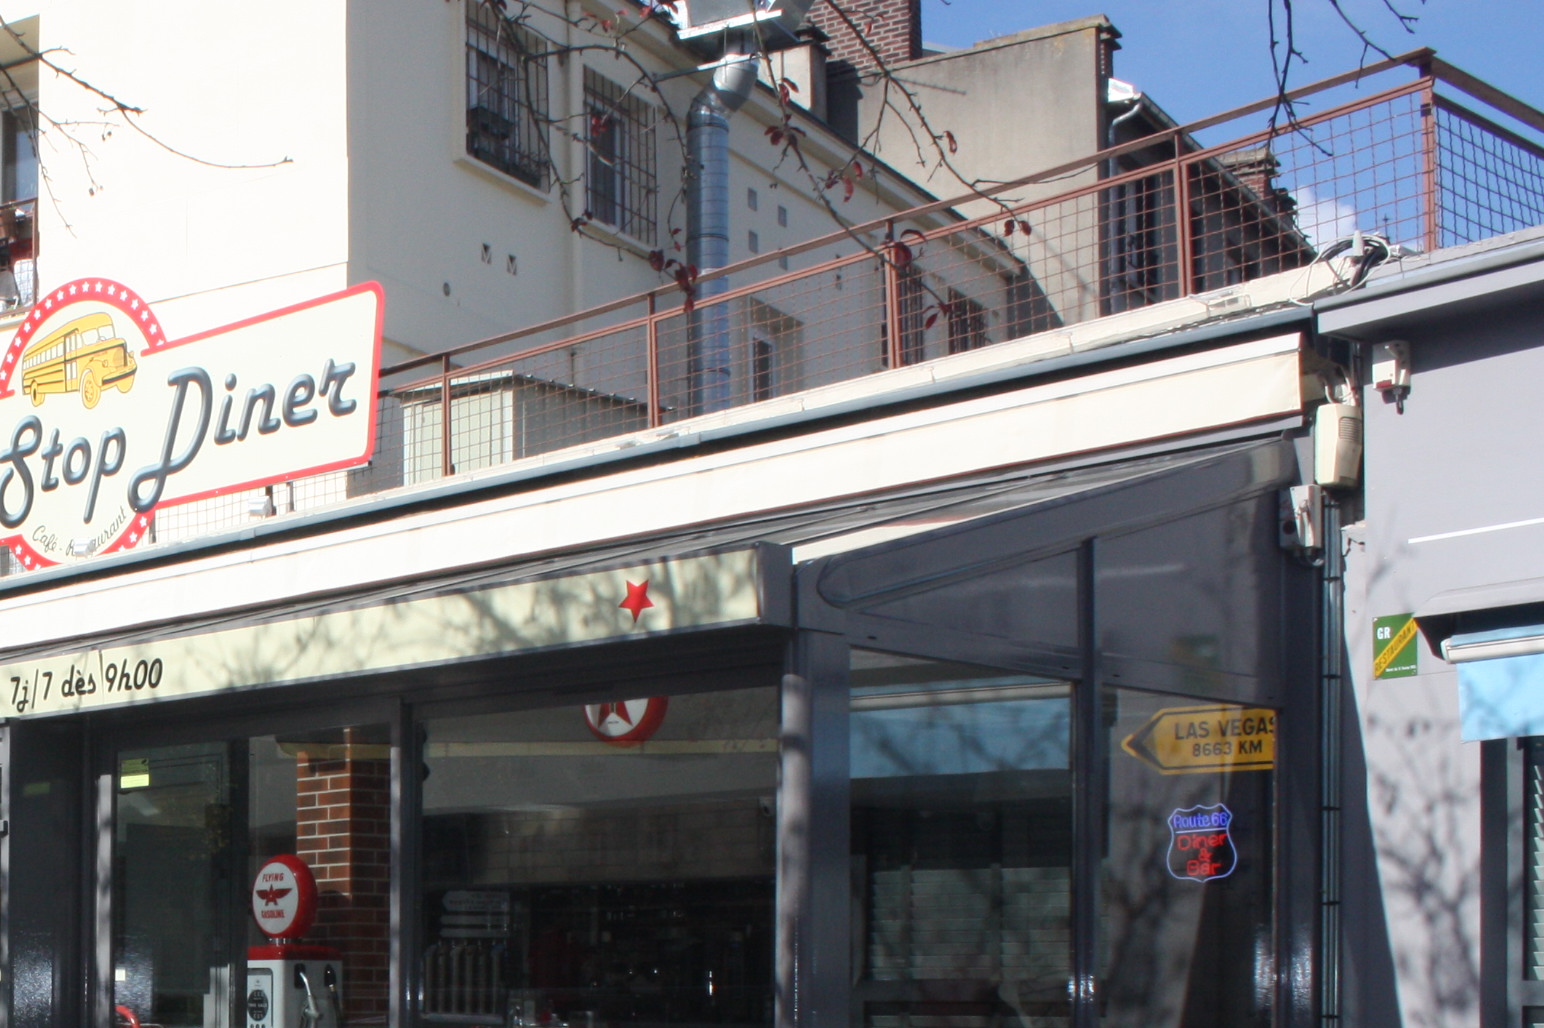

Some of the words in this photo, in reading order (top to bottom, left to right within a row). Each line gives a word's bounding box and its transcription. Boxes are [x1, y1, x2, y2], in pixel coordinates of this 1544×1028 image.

[127, 357, 358, 514] Diner
[32, 525, 58, 553] Café
[1376, 626, 1391, 640] GR
[10, 668, 53, 713] 7j/7
[61, 664, 97, 698] dès
[105, 657, 163, 693] 9h00
[1174, 721, 1209, 741] LAS
[1192, 742, 1233, 757] 8663
[1238, 739, 1263, 755] KM
[1173, 814, 1211, 829] Route
[1211, 812, 1229, 826] 66
[1176, 833, 1229, 850] Diner
[1198, 848, 1213, 862] &
[1186, 860, 1221, 876] Bar
[262, 873, 285, 882] FLYING
